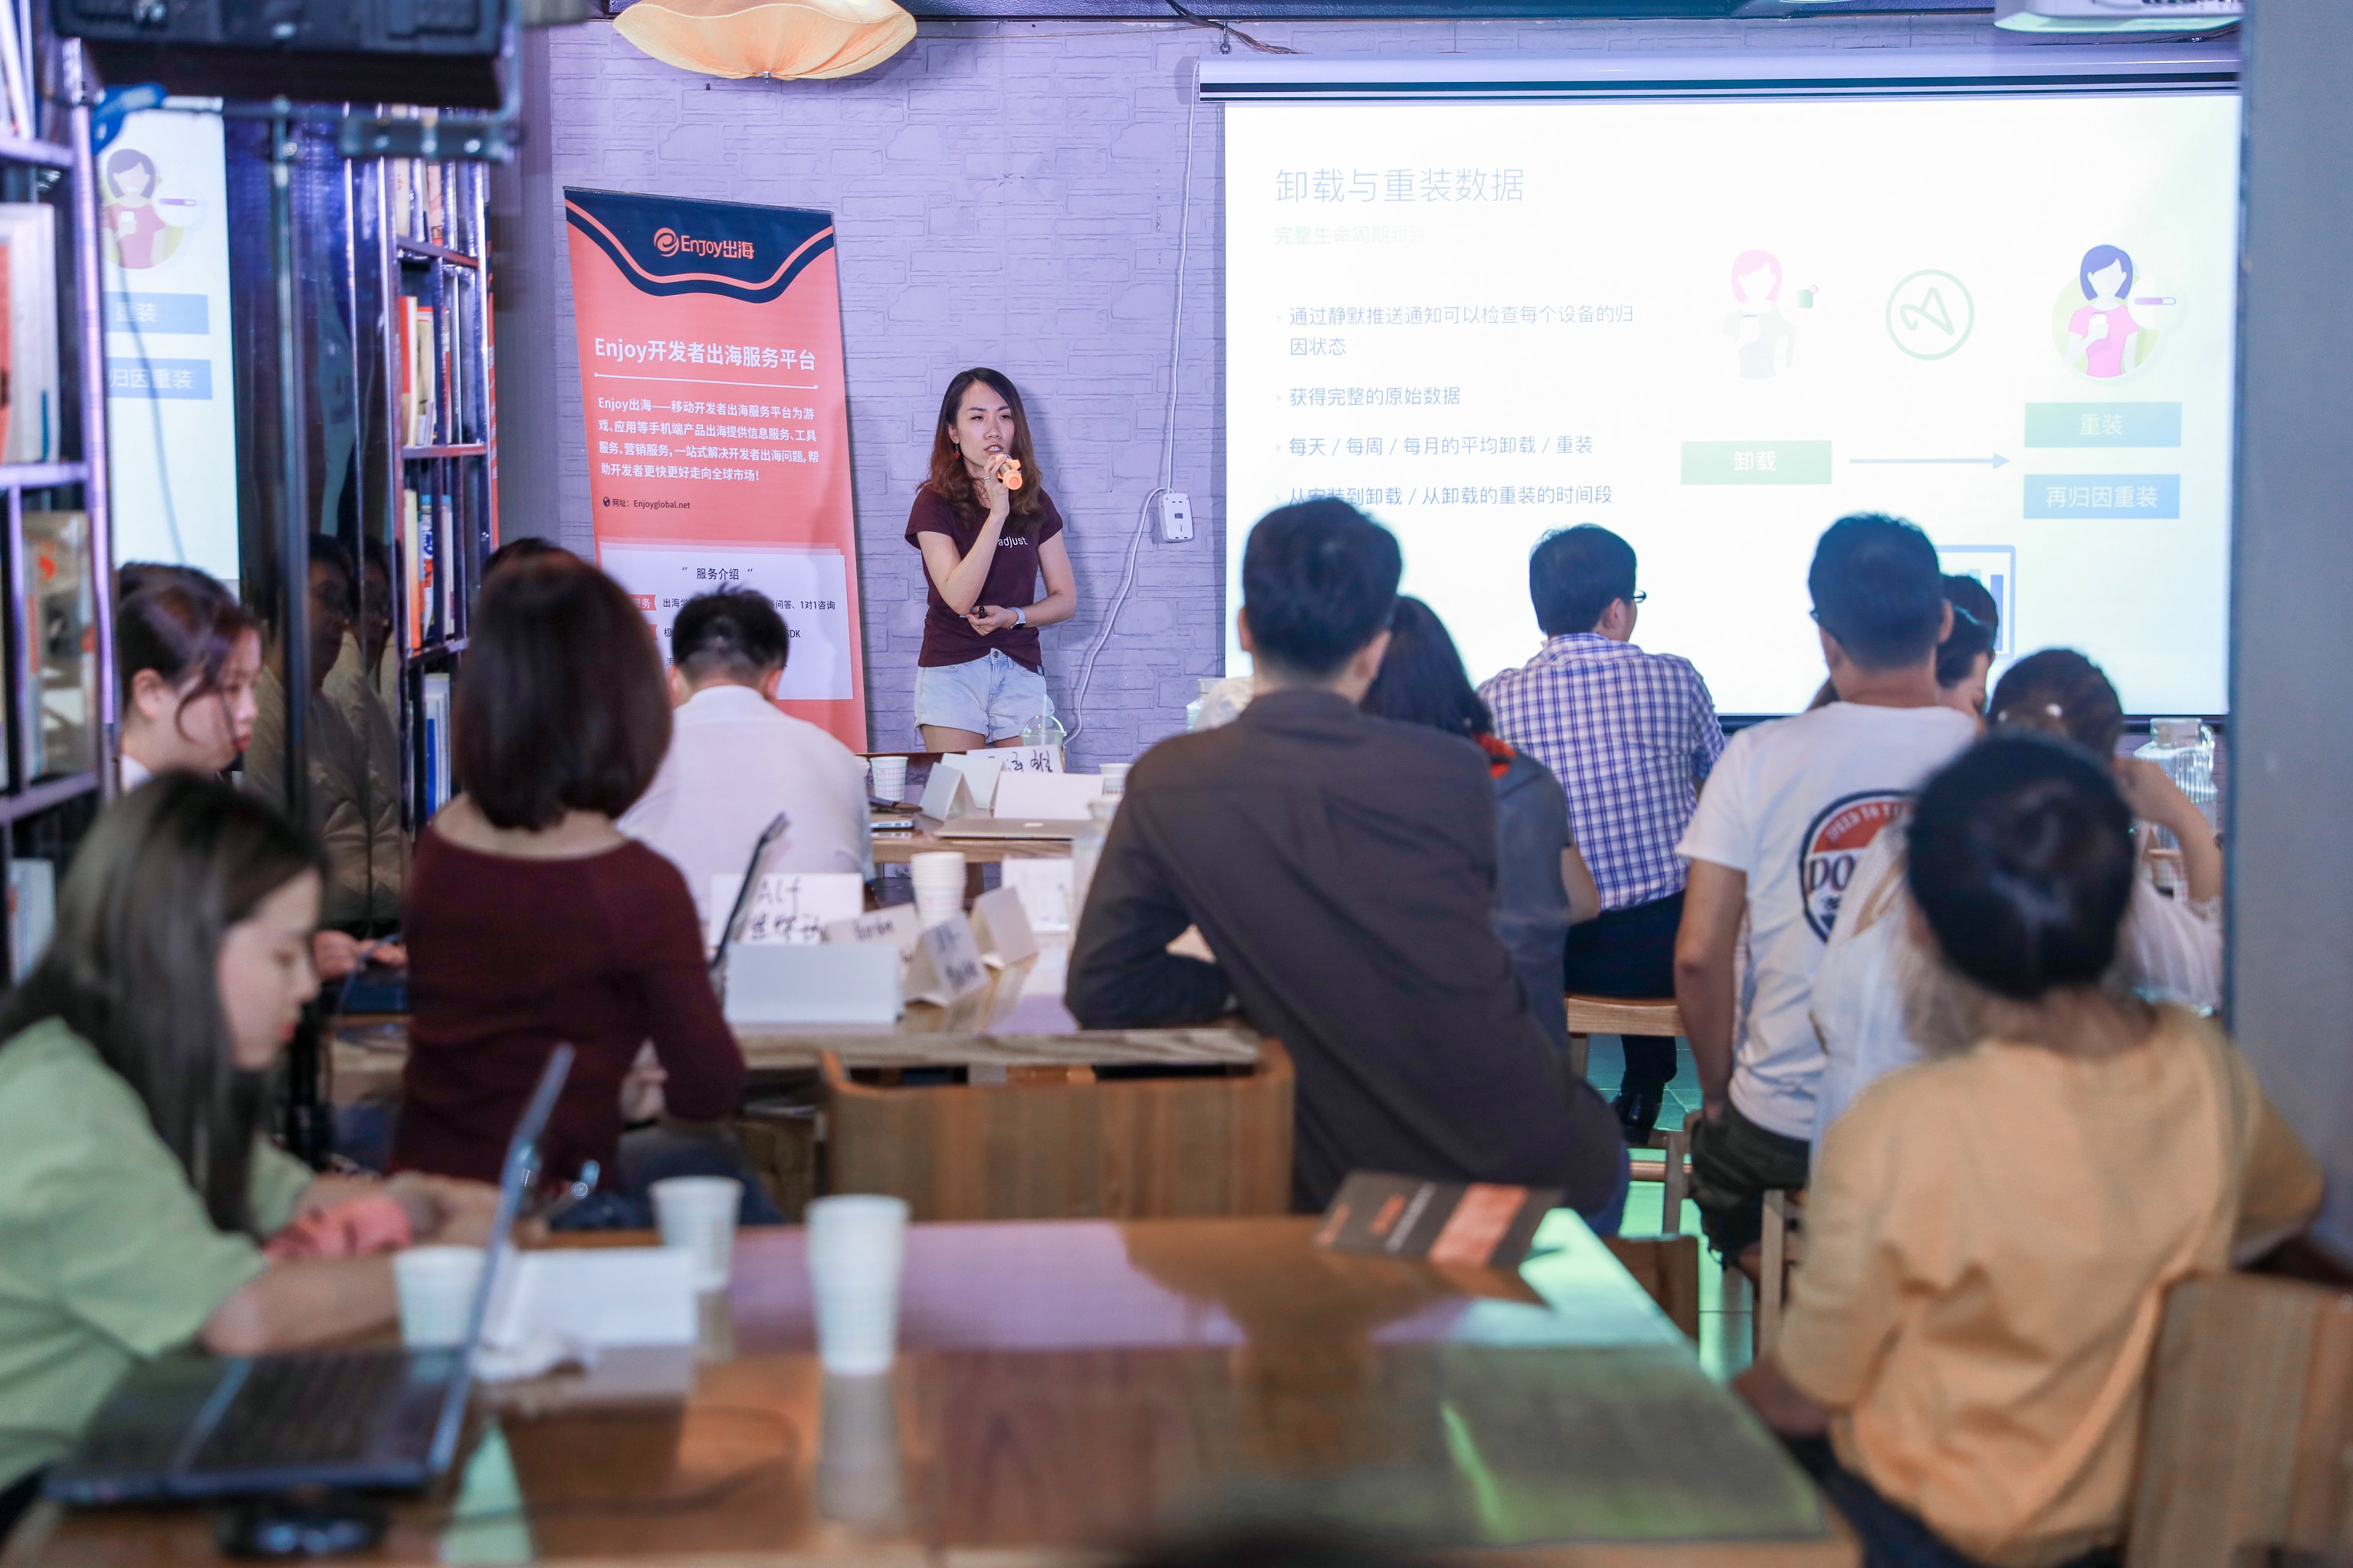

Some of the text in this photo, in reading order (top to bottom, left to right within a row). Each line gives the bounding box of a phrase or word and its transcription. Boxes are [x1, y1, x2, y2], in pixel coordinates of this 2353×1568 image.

[1275, 168, 1524, 203] 卸载与重装数据
[1289, 304, 1634, 326] 通过静默推送通知可以检查每个设备的归
[594, 337, 817, 372] Enjoy开发者出海服务平台
[1289, 337, 1347, 357] 因状态
[1288, 387, 1461, 408] 获得完整的原始数据
[2078, 413, 2124, 438] 重装
[1288, 438, 1327, 458] 每天
[1346, 437, 1383, 456] 每周
[1403, 435, 1536, 456] 每月的平均卸载
[1556, 435, 1593, 454] 重装
[1733, 450, 1777, 474] 卸载
[1422, 484, 1613, 506] 从卸载的重装的时间段
[2046, 484, 2159, 509] 再归因重装
[997, 536, 1029, 549] adjust
[696, 567, 740, 581] 服务介绍
